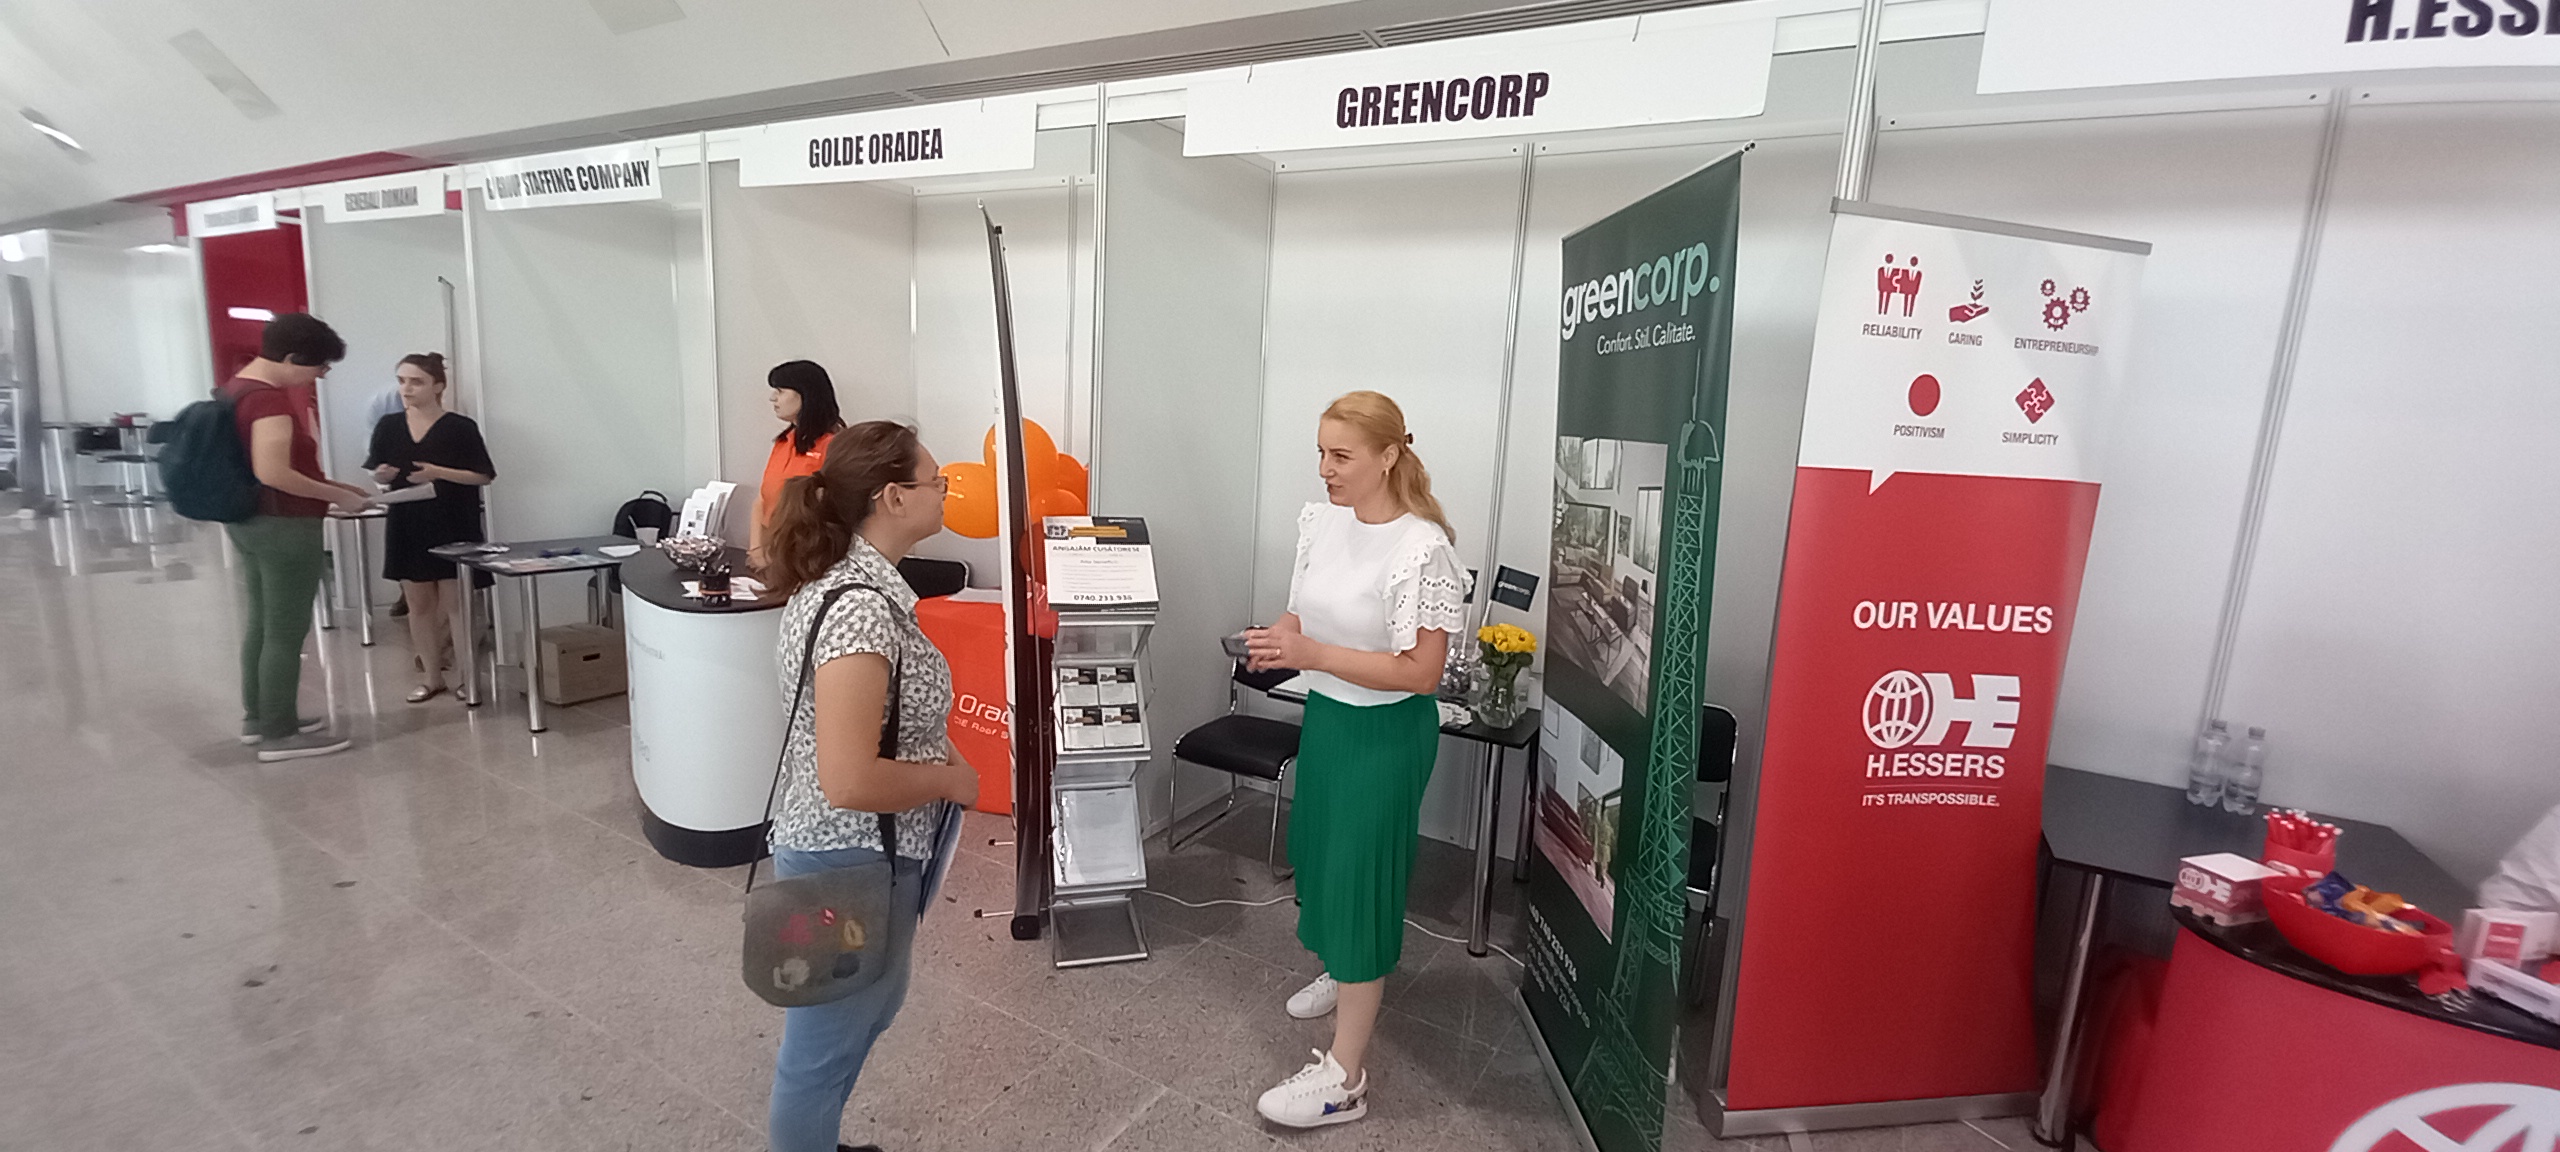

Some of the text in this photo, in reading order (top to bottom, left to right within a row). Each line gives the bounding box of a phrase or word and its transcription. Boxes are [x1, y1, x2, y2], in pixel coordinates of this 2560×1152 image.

[1336, 72, 1549, 129] GREENCORP
[809, 128, 943, 168] GOLDE ORADEA
[521, 167, 577, 197] STAFFING
[576, 160, 651, 192] COMPANY
[1561, 241, 1721, 341] greencorp.
[1652, 321, 1696, 347] Calitate.
[1861, 323, 1923, 340] RELIABILITY
[1948, 332, 1983, 347] CARING
[2013, 337, 2100, 356] ENTREPRENEURSHIP
[1893, 424, 1946, 439] POSITIVISM
[2001, 431, 2060, 446] SIMPLICITY
[1853, 600, 2054, 634] OUR VALUES
[971, 722, 998, 736] Roof
[1865, 752, 2006, 779] H.ESSERS
[1862, 792, 2001, 808] IT'S TRANSPOSSIBLE.
